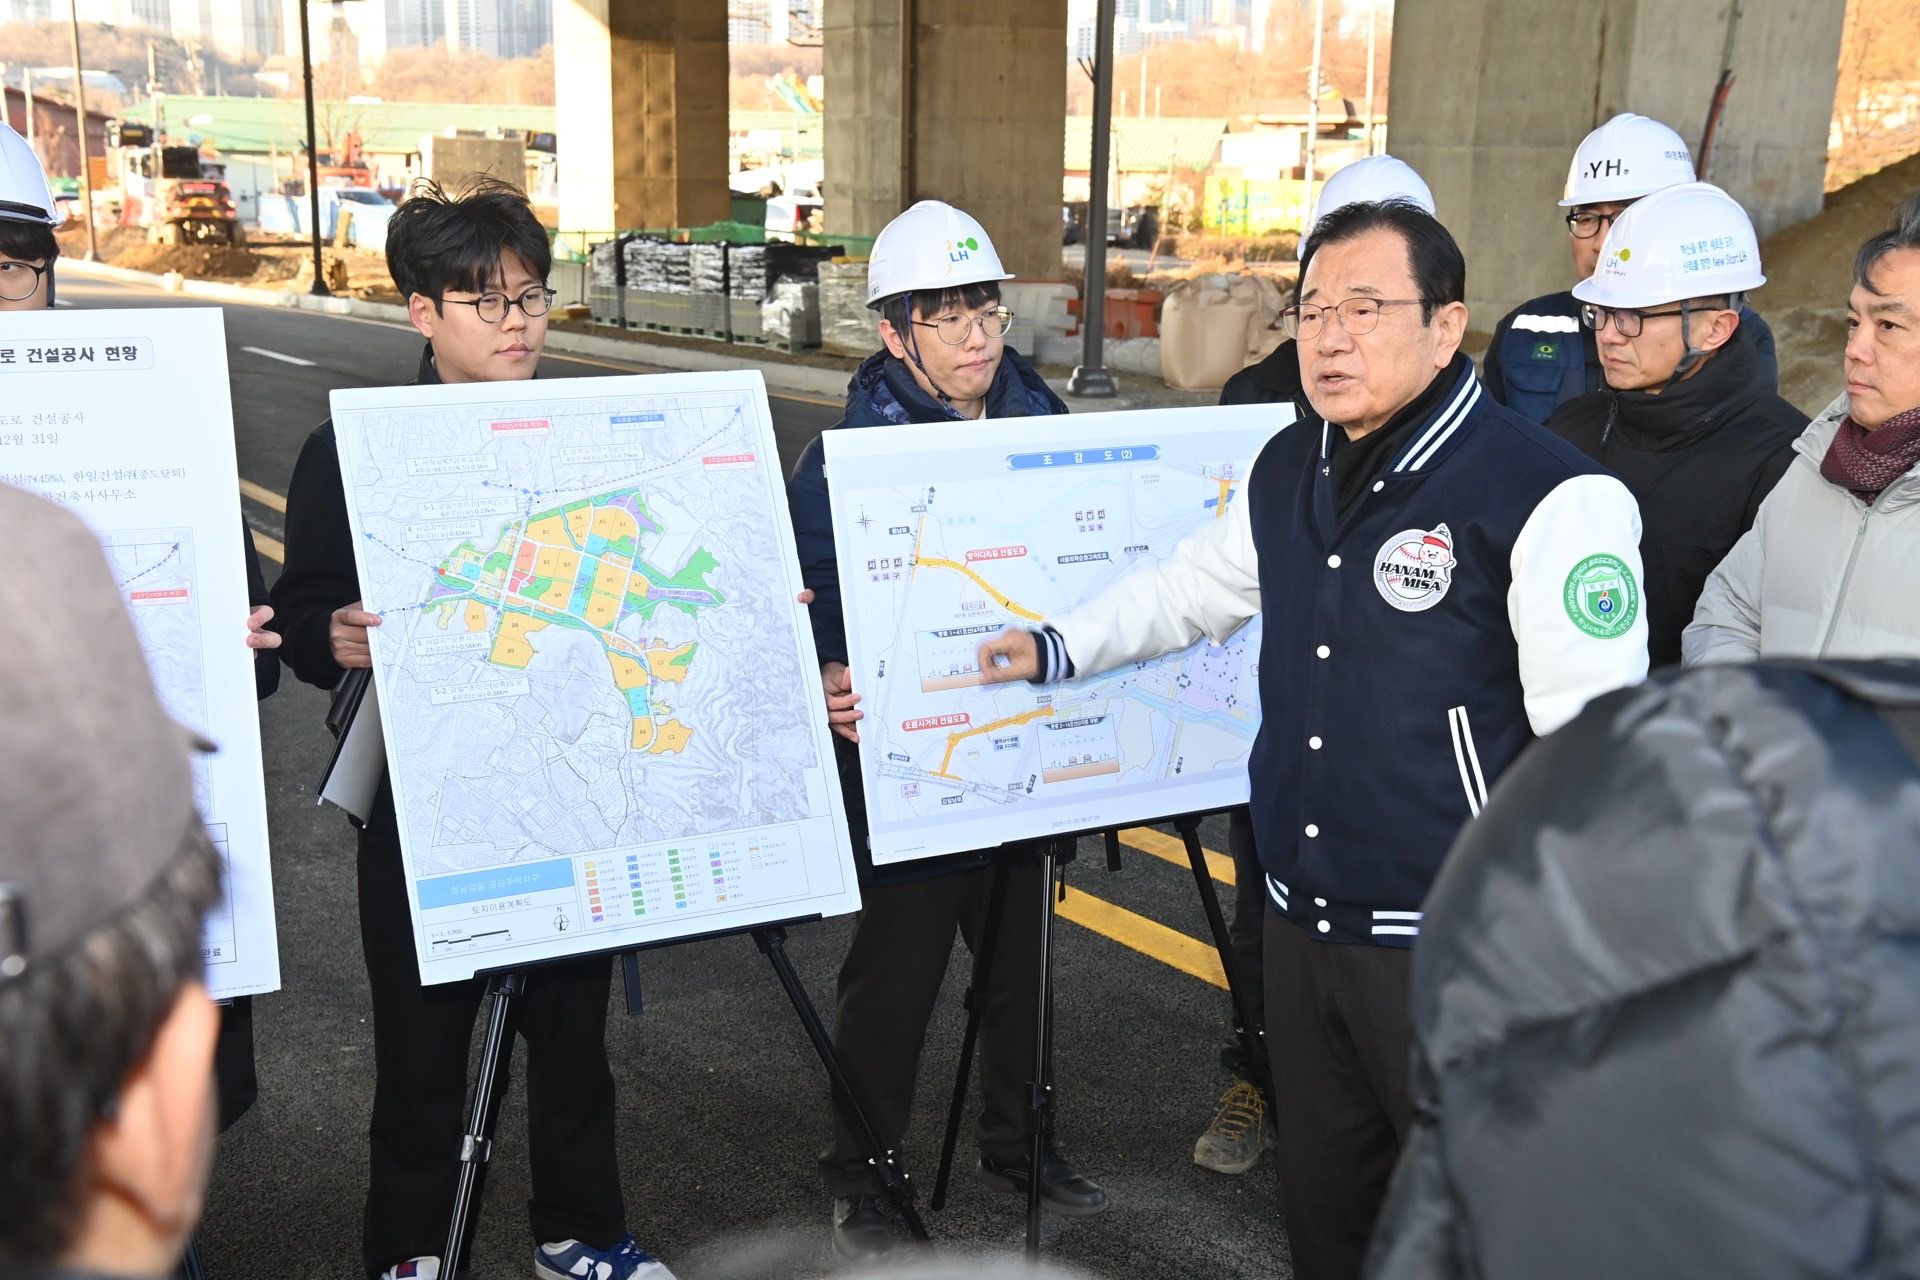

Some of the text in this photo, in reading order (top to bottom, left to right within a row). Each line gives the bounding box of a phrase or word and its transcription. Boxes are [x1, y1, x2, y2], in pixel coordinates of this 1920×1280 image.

[950, 250, 969, 262] LH
[1712, 257, 1724, 267] New
[1725, 254, 1739, 265] Start
[26, 346, 95, 364] 건설공사
[104, 344, 138, 361] 현황
[31, 410, 86, 425] 건설공사
[32, 431, 60, 445] 31일
[1120, 448, 1132, 460] (2)
[1379, 561, 1435, 579] HANAM
[1401, 576, 1441, 591] MISA
